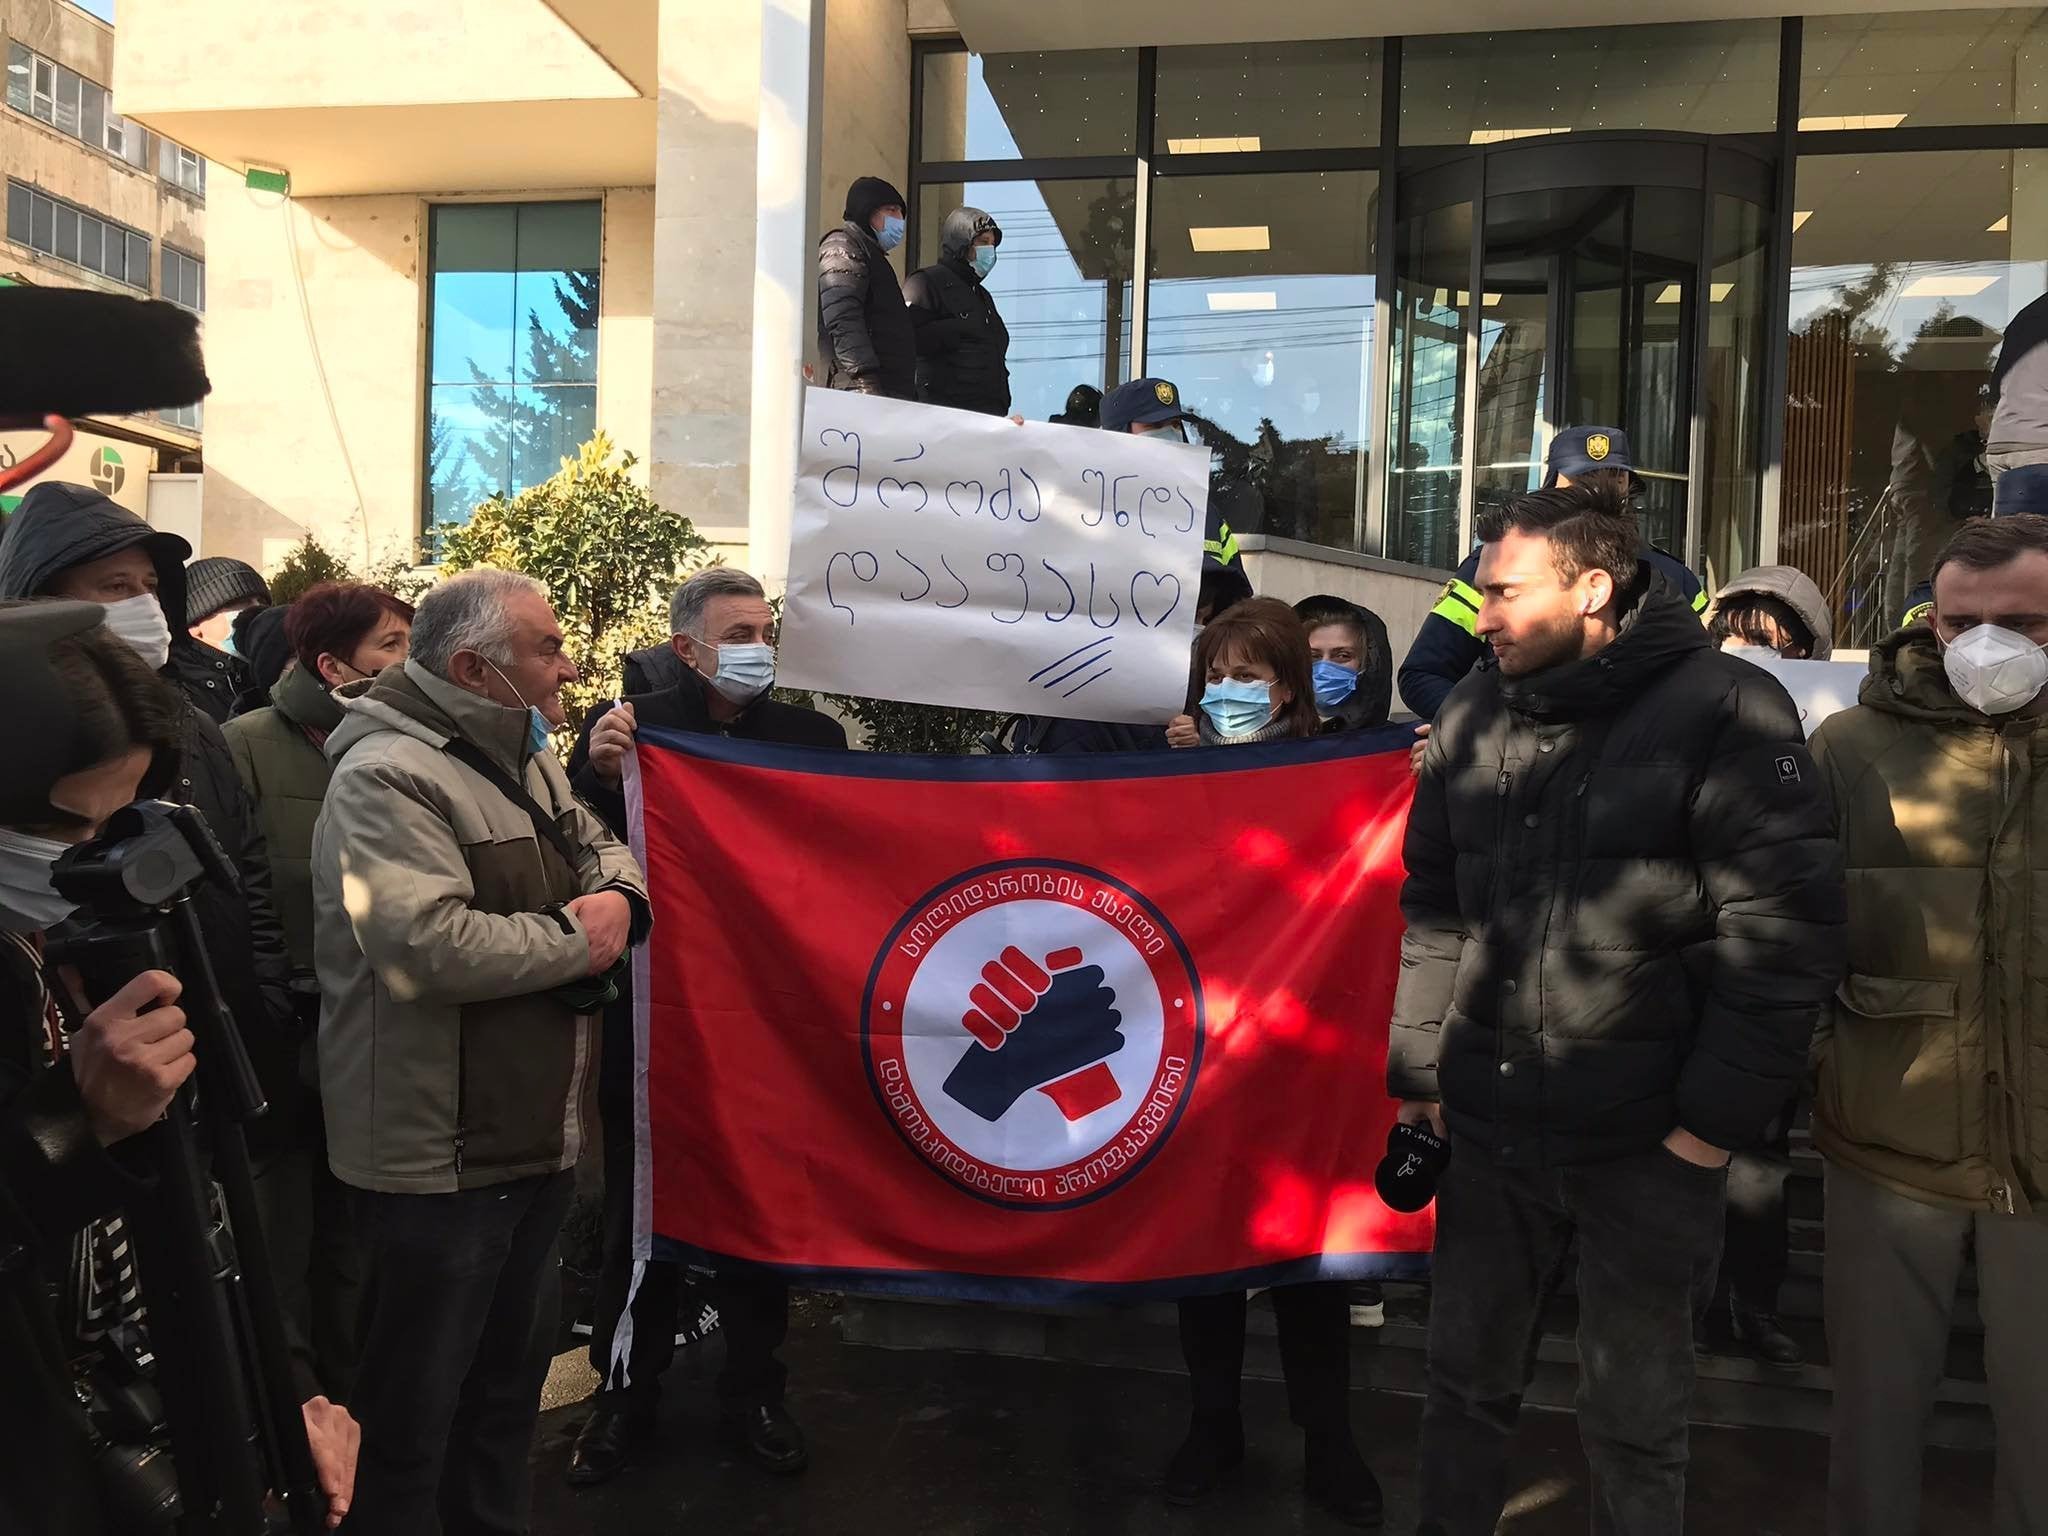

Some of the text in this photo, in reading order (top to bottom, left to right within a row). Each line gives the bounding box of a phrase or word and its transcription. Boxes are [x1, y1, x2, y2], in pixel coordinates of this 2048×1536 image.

[819, 428, 1195, 538] შრომა უნდა
[826, 549, 1181, 630] დააფასო
[900, 873, 1165, 958] სოლიდარობის ქსელი
[879, 1055, 1187, 1198] დამოუკიდებელი პროფკავშირი
